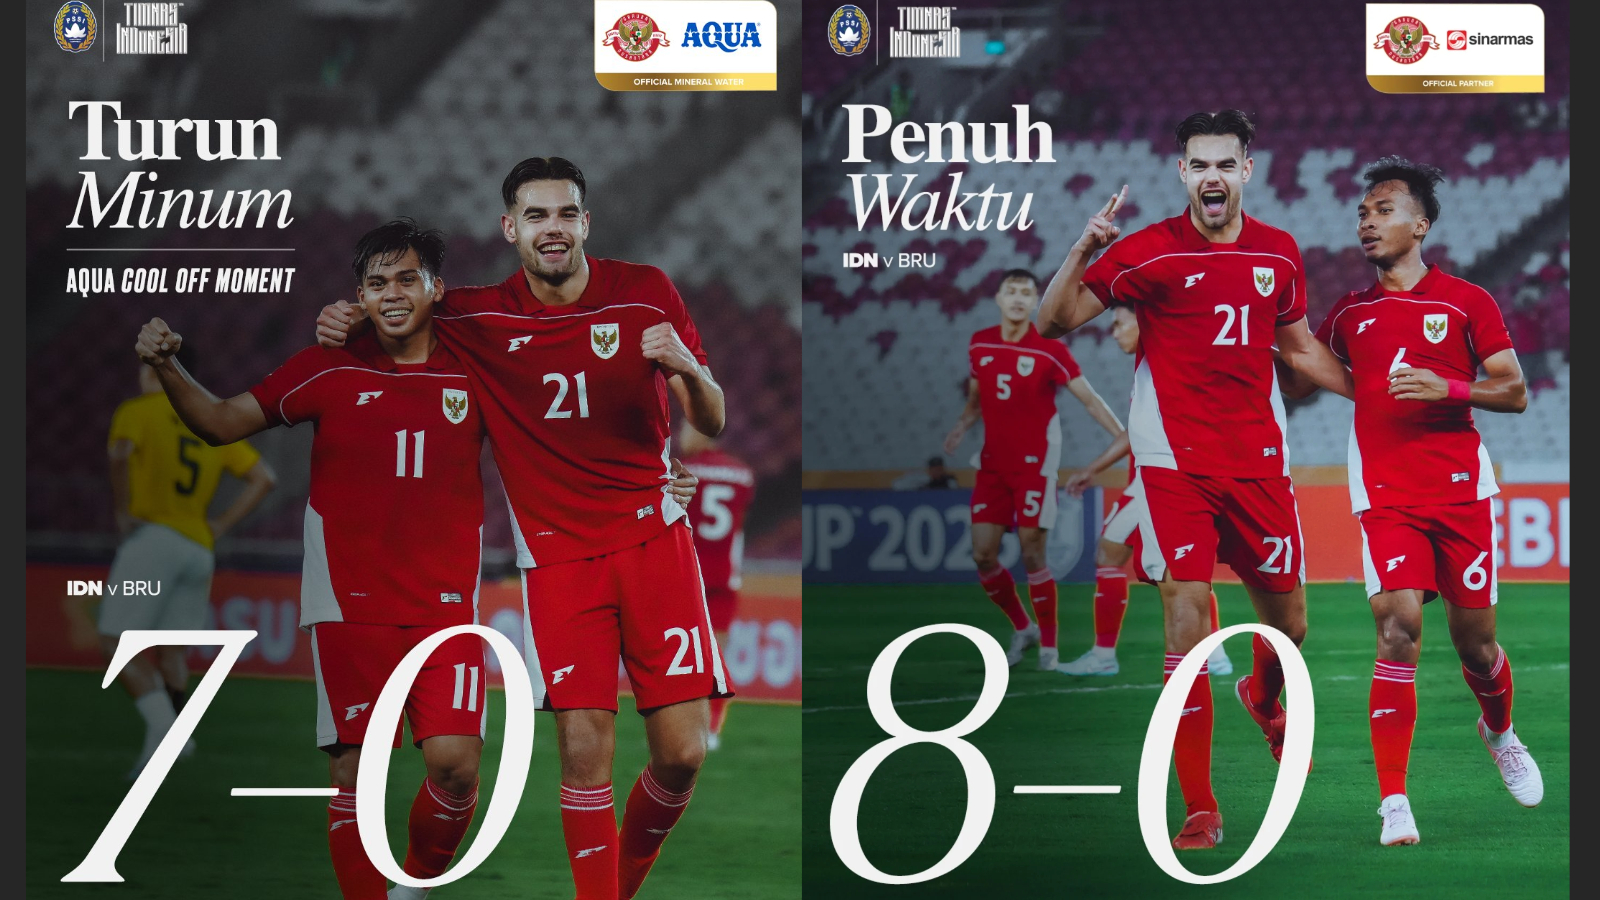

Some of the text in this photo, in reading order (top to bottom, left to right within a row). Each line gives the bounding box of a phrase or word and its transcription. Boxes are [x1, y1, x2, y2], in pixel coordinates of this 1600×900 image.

[1212, 304, 1250, 346] 21
[543, 371, 589, 419] 21
[996, 373, 1012, 400] 5
[175, 436, 199, 496] 5
[395, 429, 425, 478] 11
[697, 484, 735, 541] 5
[1022, 490, 1042, 517] 5
[1257, 535, 1292, 575] 21
[1463, 551, 1488, 591] 6
[664, 625, 704, 676] 21
[453, 662, 479, 712] 11
